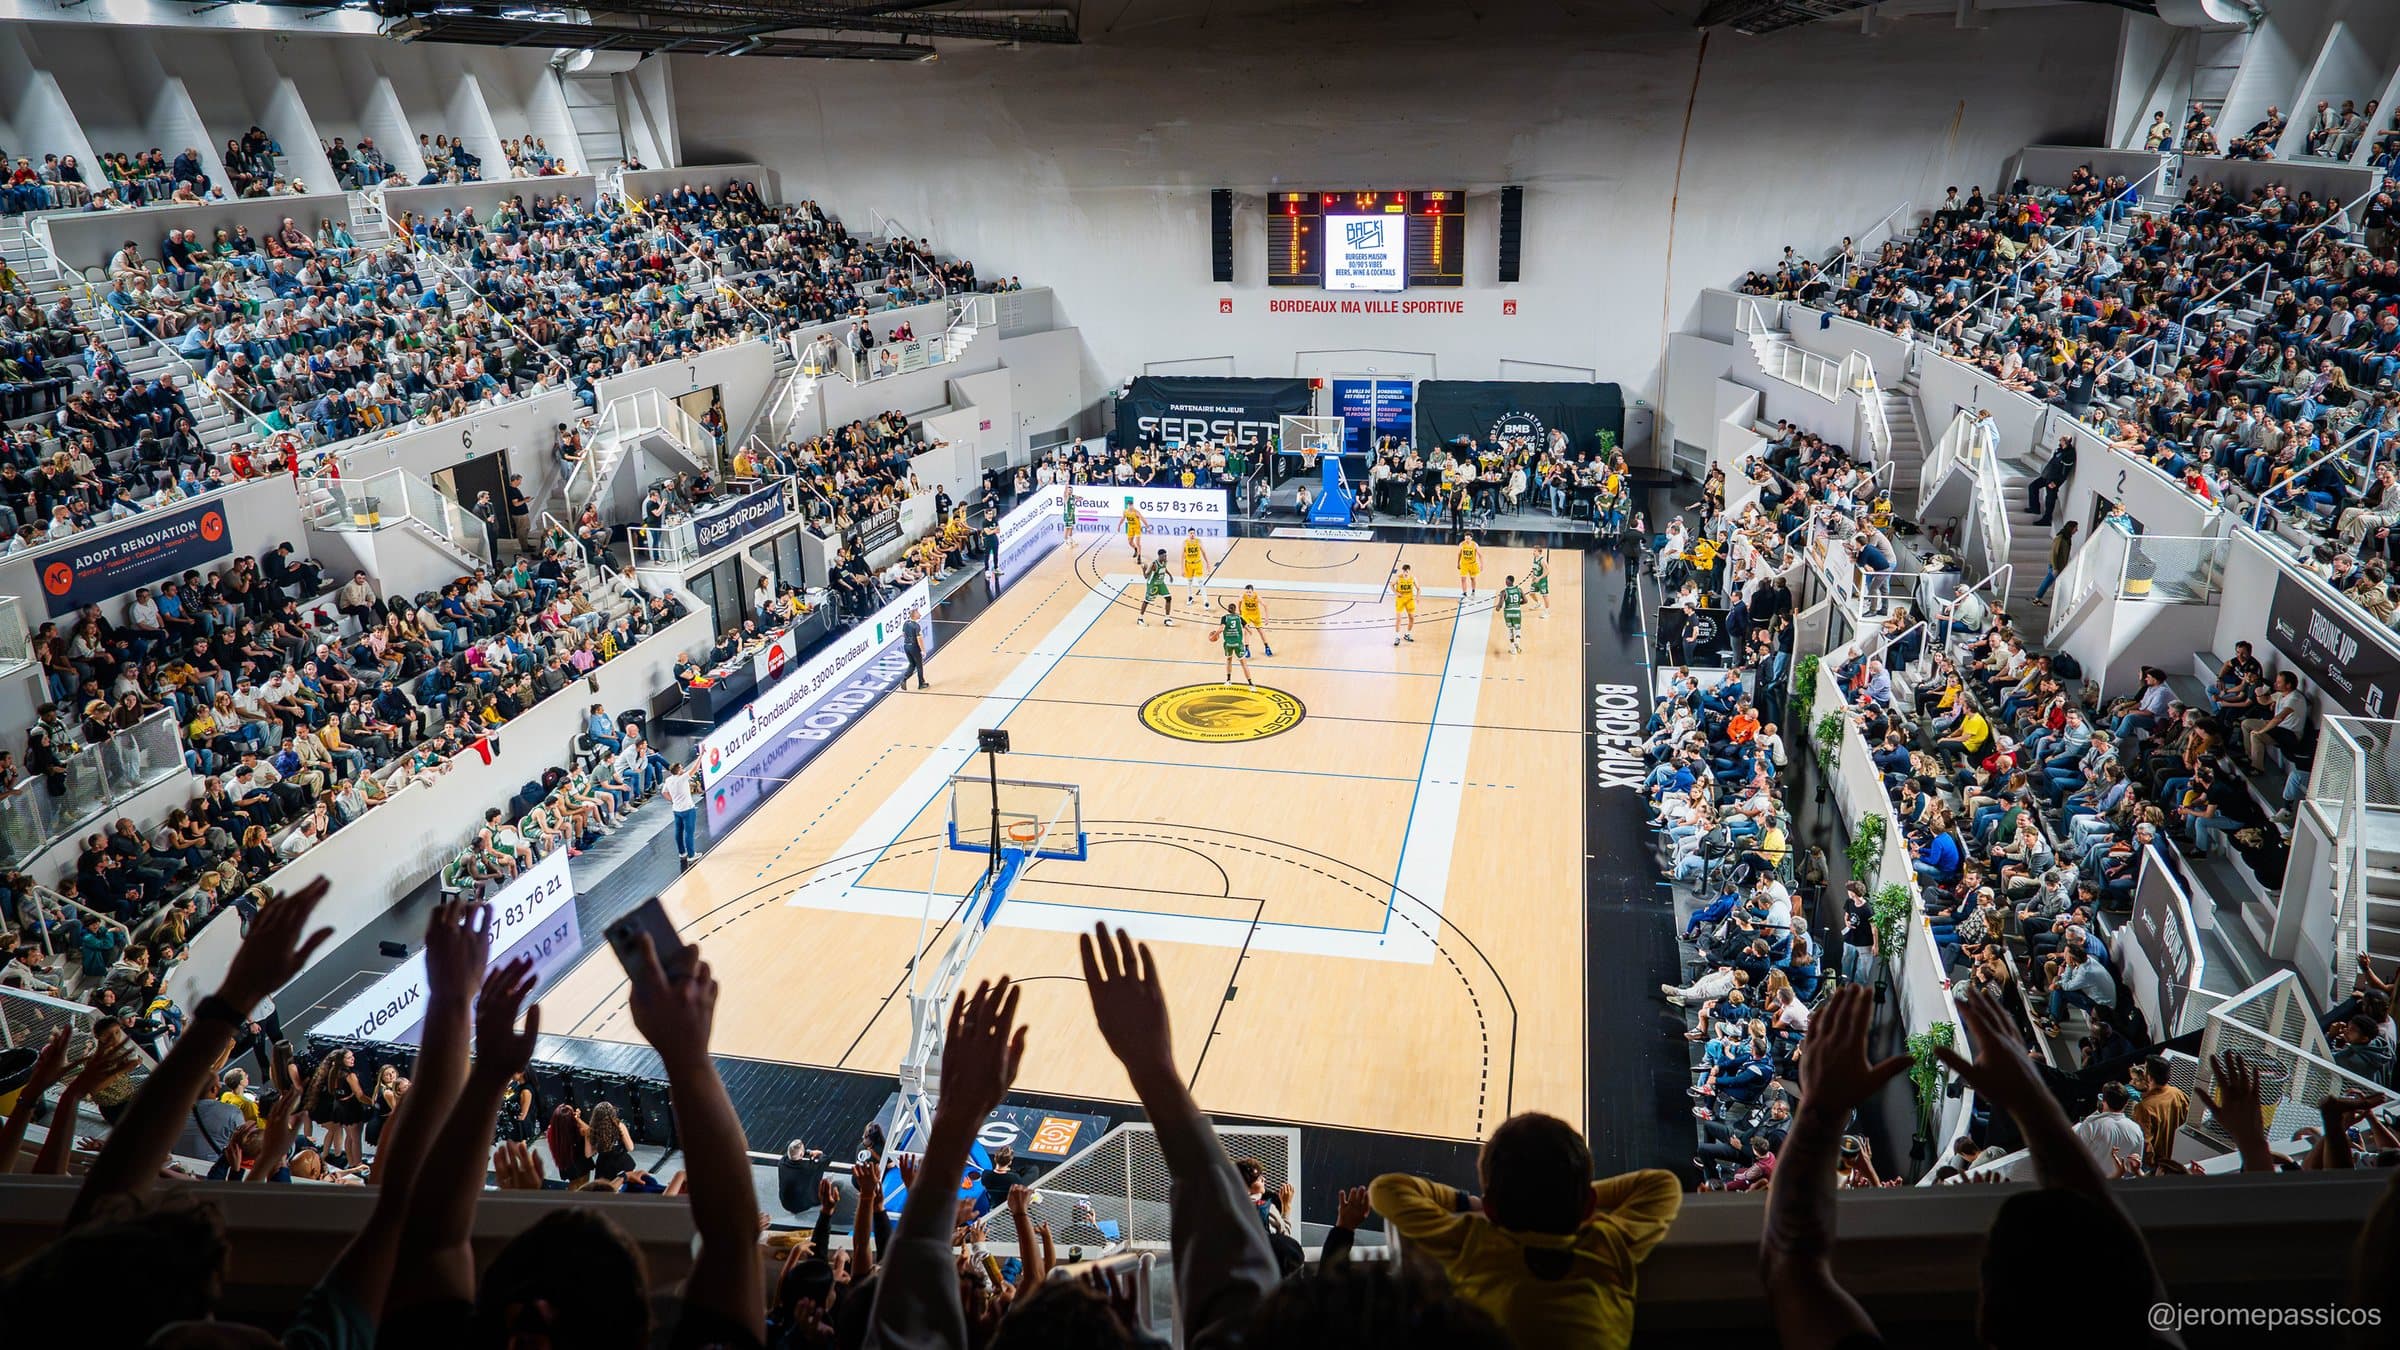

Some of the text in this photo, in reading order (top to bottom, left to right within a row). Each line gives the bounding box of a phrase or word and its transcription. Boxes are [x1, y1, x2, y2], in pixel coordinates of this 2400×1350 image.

[1269, 299, 1464, 314] BORDEAUX MA VILLE SPORTIVE
[688, 366, 697, 382] 7
[1170, 404, 1245, 414] PARTENAIRE MAJEUR
[462, 430, 473, 449] 6
[1137, 416, 1280, 446] SERSET
[1504, 424, 1530, 434] BMB
[2116, 468, 2126, 494] 2
[728, 493, 780, 530] BORDEAUX
[1056, 496, 1110, 508] Bdeaux
[1139, 500, 1219, 513] 05 57 83 76 21
[76, 546, 118, 570] ADOPT
[121, 520, 198, 554] RENOVATION
[1509, 594, 1518, 603] 19
[885, 620, 894, 634] 05
[895, 613, 902, 629] 57
[1230, 620, 1236, 628] 3
[2308, 608, 2342, 657] TRIBUNE
[2338, 632, 2358, 666] VIP
[724, 737, 740, 758] 101
[742, 725, 757, 745] rue
[811, 664, 835, 692] 33000
[835, 639, 870, 672] Bordeaux
[1253, 693, 1296, 737] SERSET
[1595, 683, 1646, 789] BORDEAUX
[505, 904, 524, 927] 83
[526, 886, 544, 915] 76
[546, 874, 562, 896] 21
